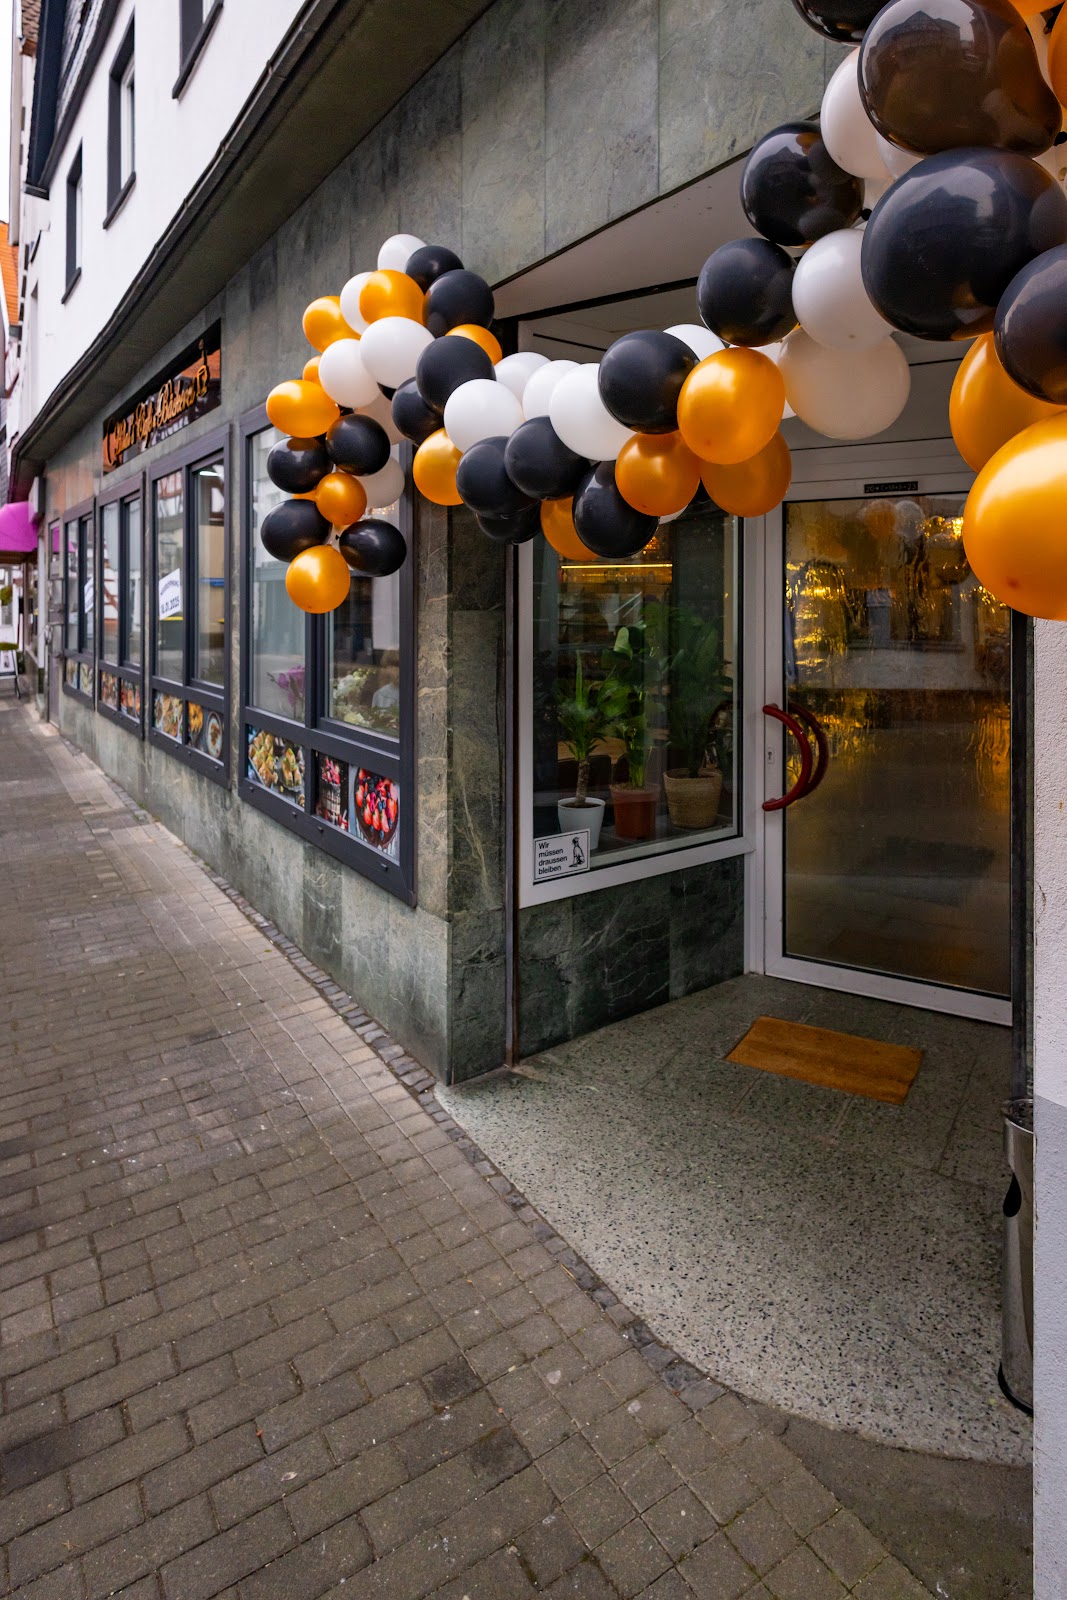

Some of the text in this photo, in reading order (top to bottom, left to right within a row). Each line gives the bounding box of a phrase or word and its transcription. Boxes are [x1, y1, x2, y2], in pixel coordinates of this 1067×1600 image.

[538, 841, 550, 850] Wir
[538, 848, 564, 858] müssen
[538, 855, 568, 866] draussen
[538, 865, 562, 875] bleiben
